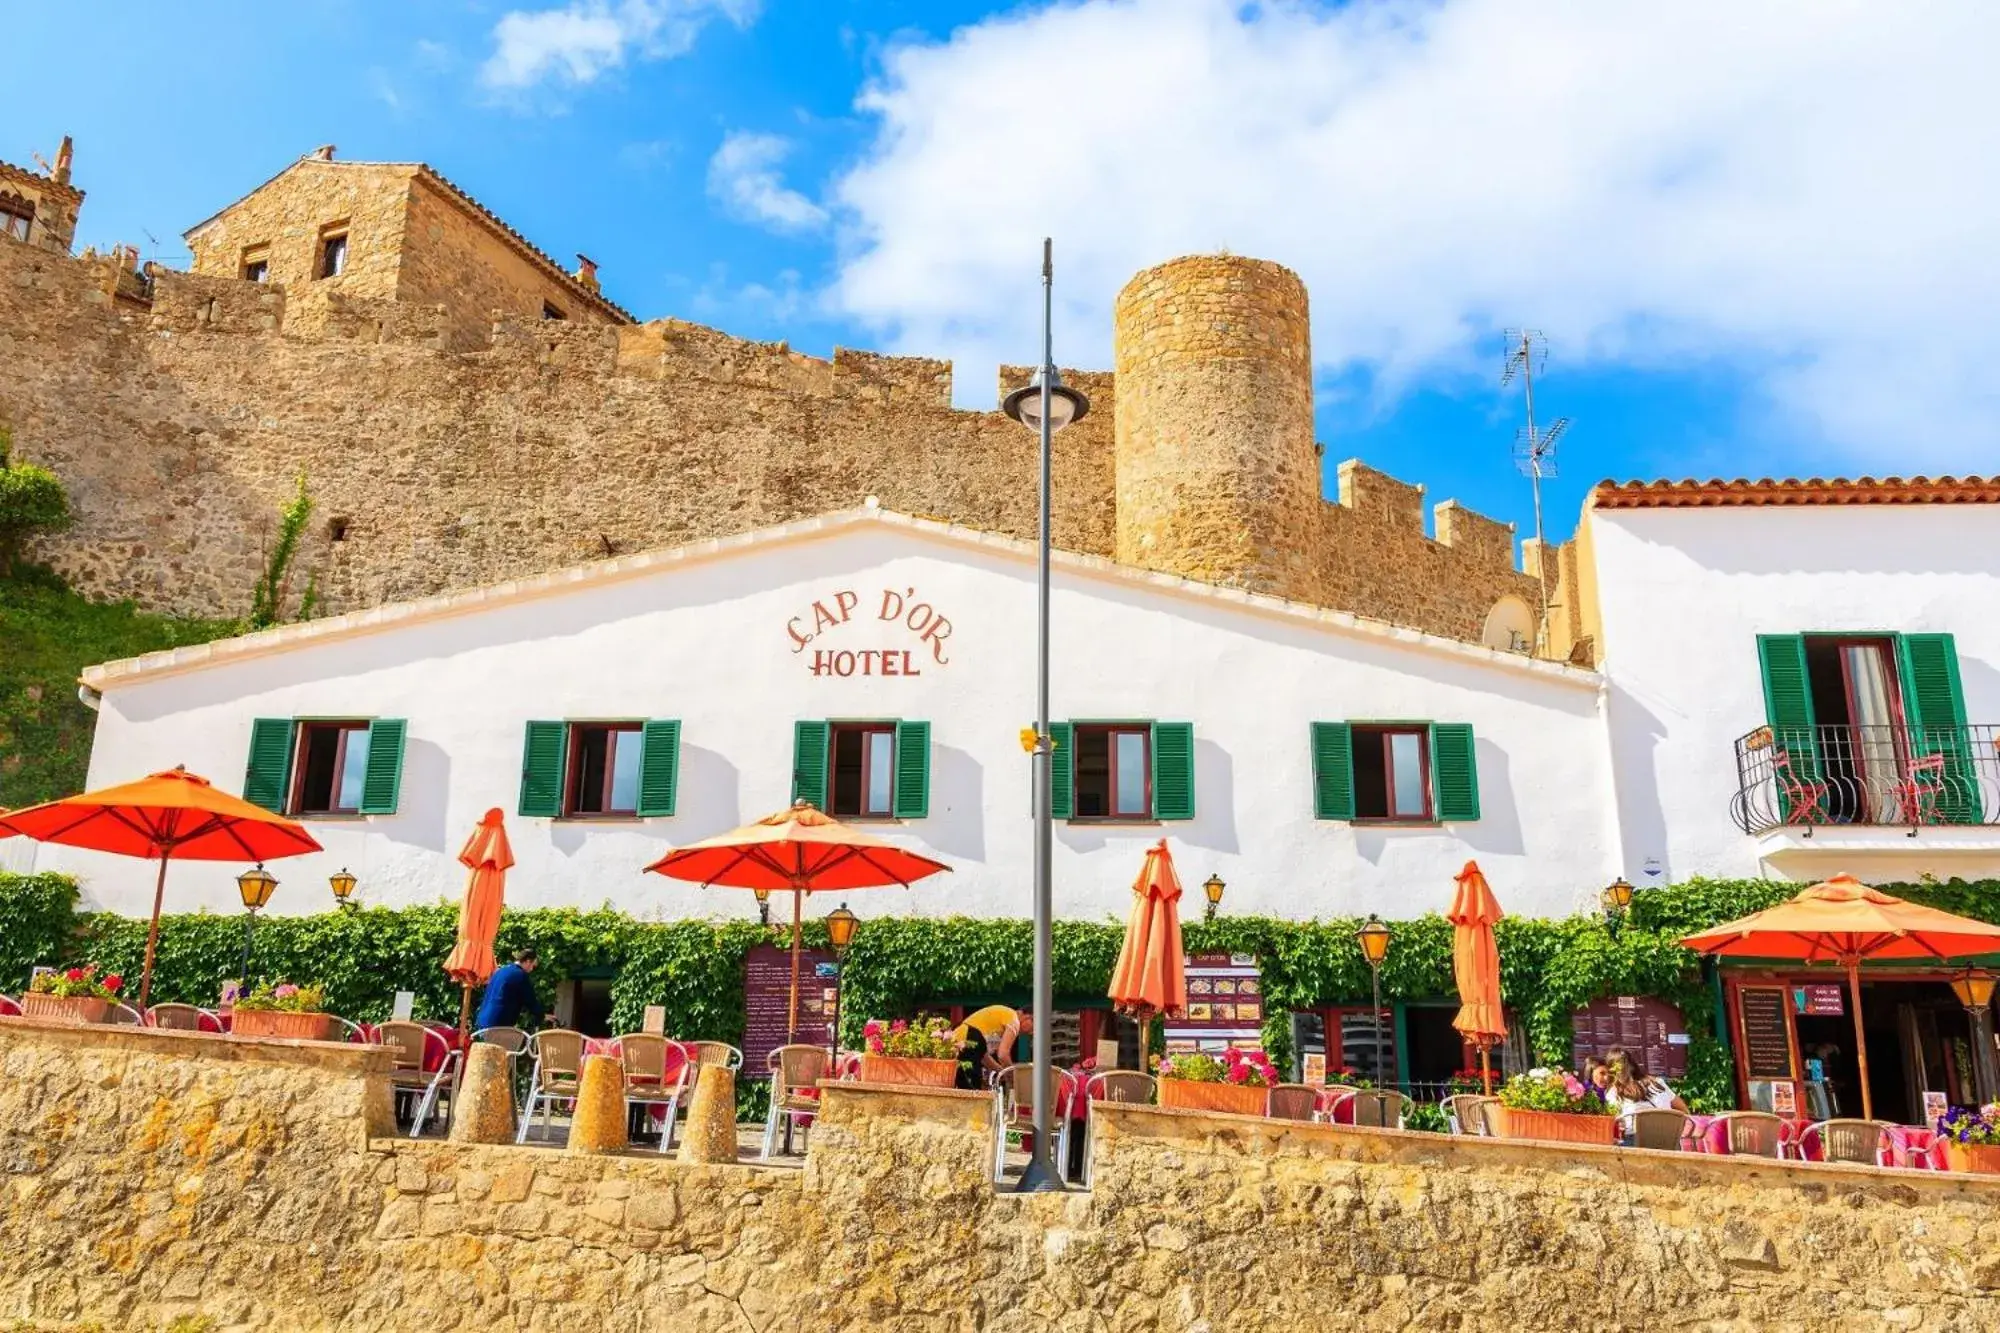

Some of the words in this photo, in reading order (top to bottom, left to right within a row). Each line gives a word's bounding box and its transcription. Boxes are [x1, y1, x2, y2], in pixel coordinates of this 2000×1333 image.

[787, 590, 858, 654] CAP
[878, 587, 953, 665] D'OR
[808, 649, 921, 677] HOTEL
